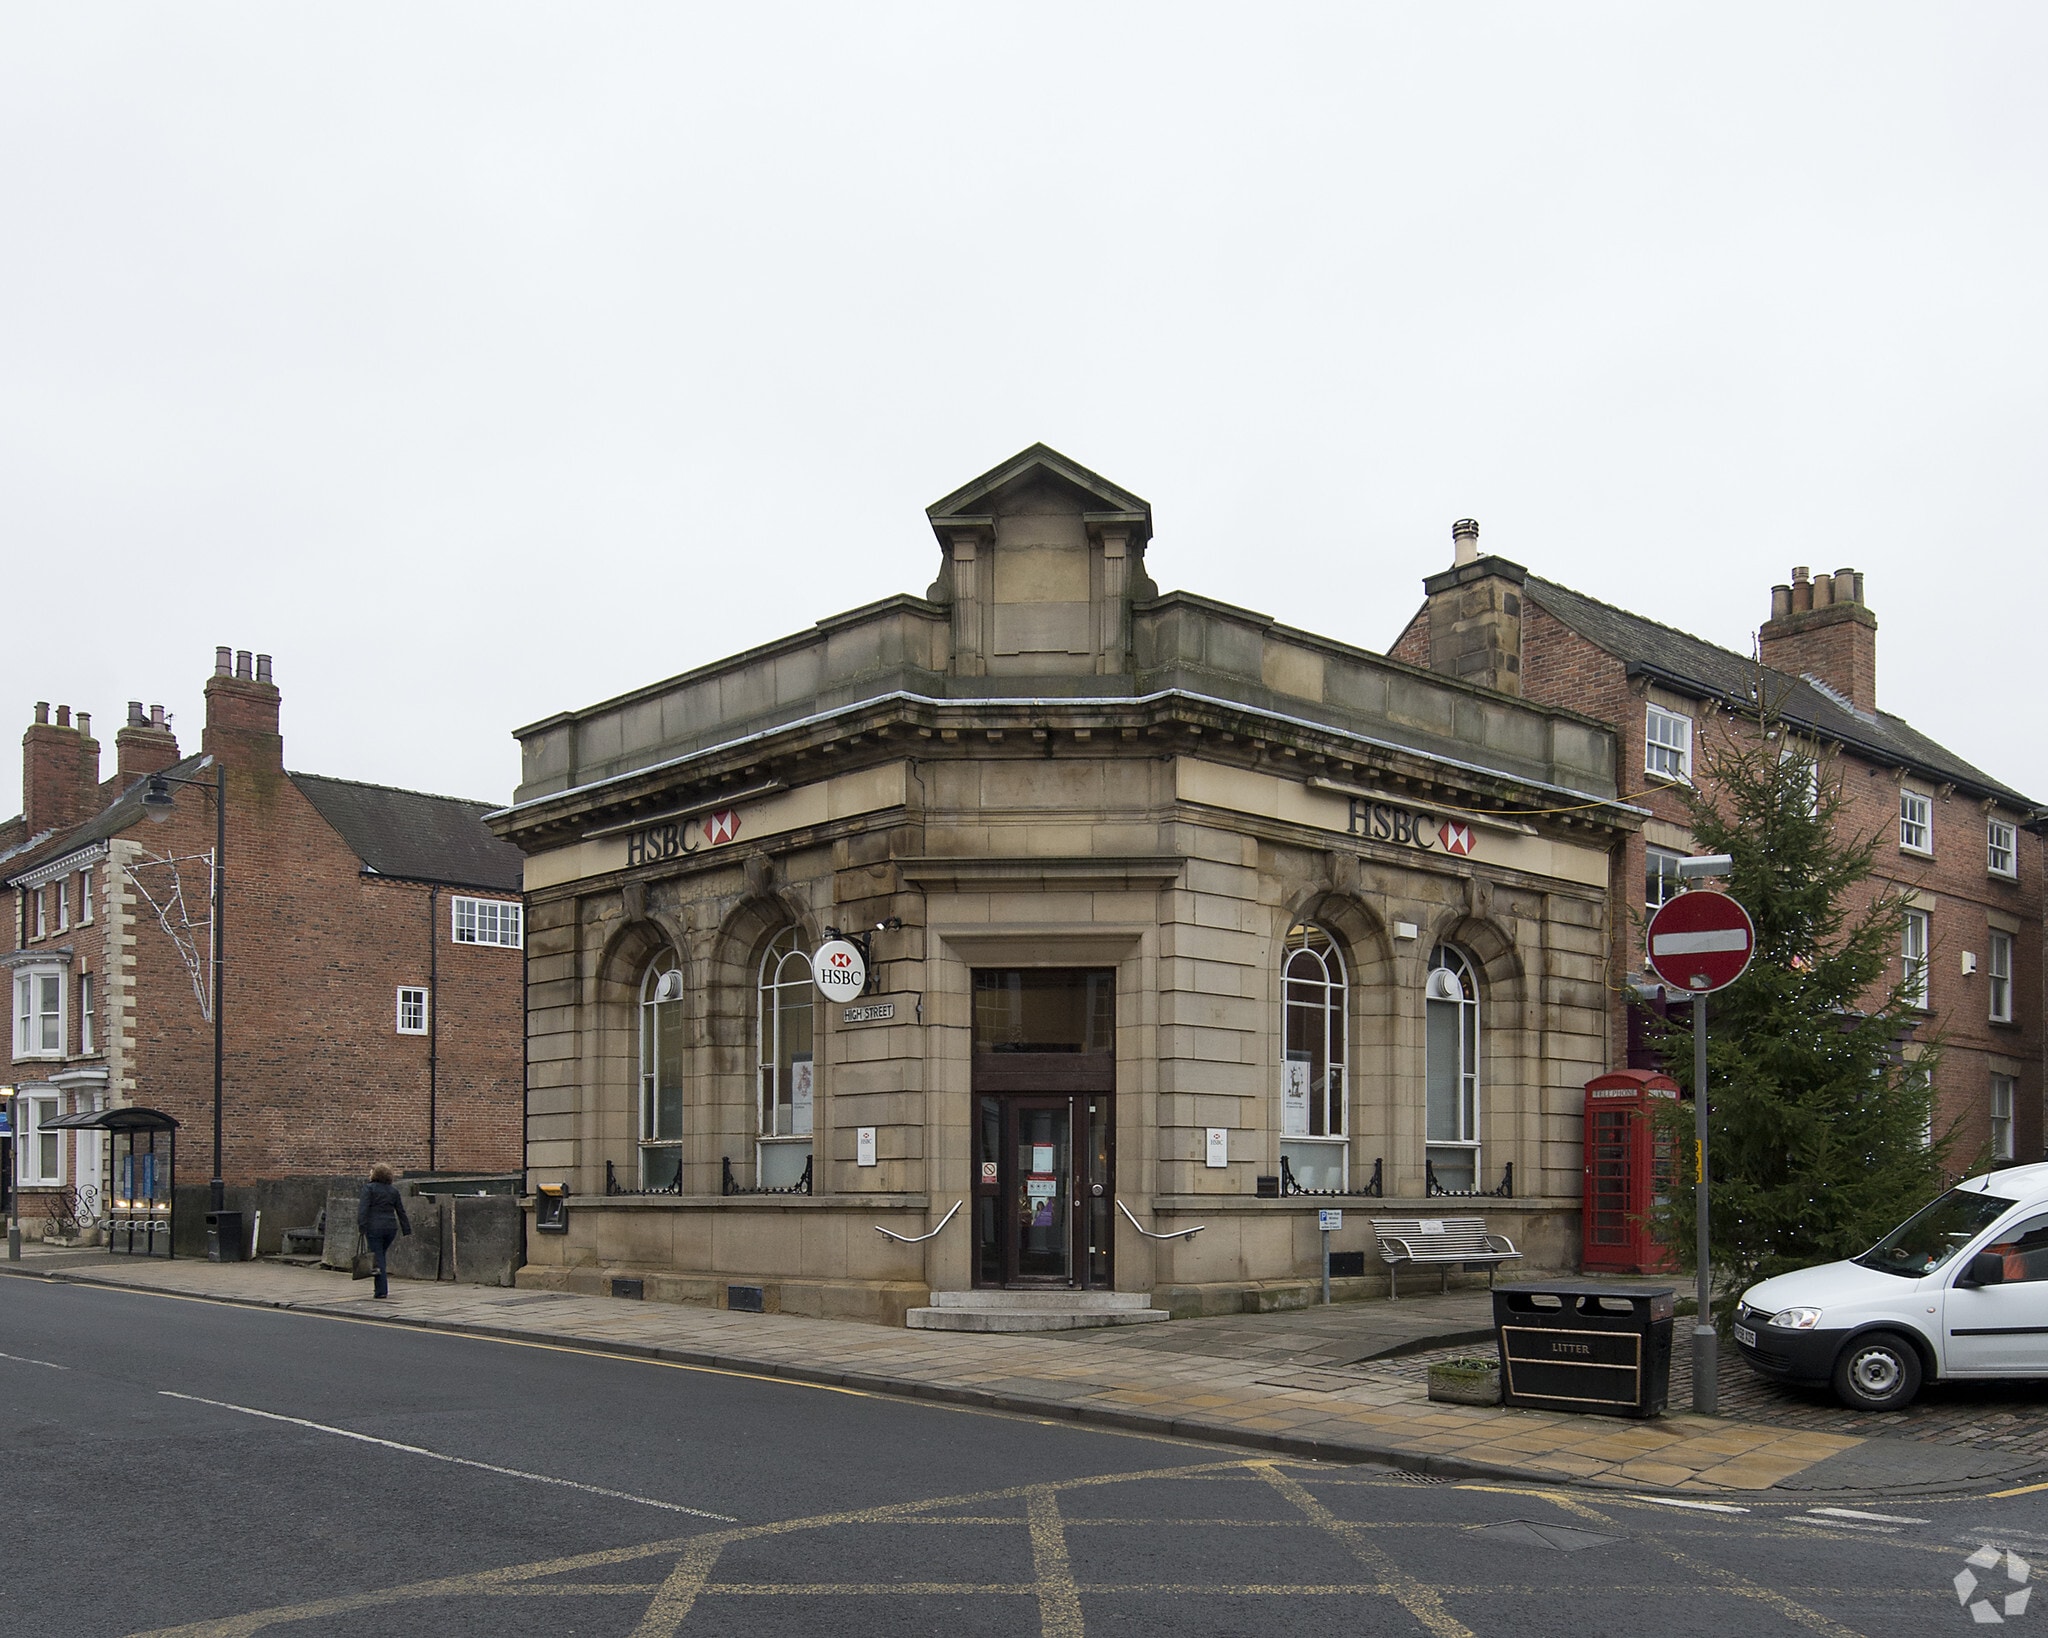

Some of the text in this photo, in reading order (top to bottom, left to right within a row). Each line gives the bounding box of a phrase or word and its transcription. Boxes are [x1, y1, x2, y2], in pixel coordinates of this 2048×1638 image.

[1347, 796, 1435, 849] HSBC
[625, 818, 700, 866] HSBC
[821, 968, 862, 986] HSBC
[844, 1004, 892, 1021] HIGH STREET
[1551, 1342, 1590, 1354] LITTER
